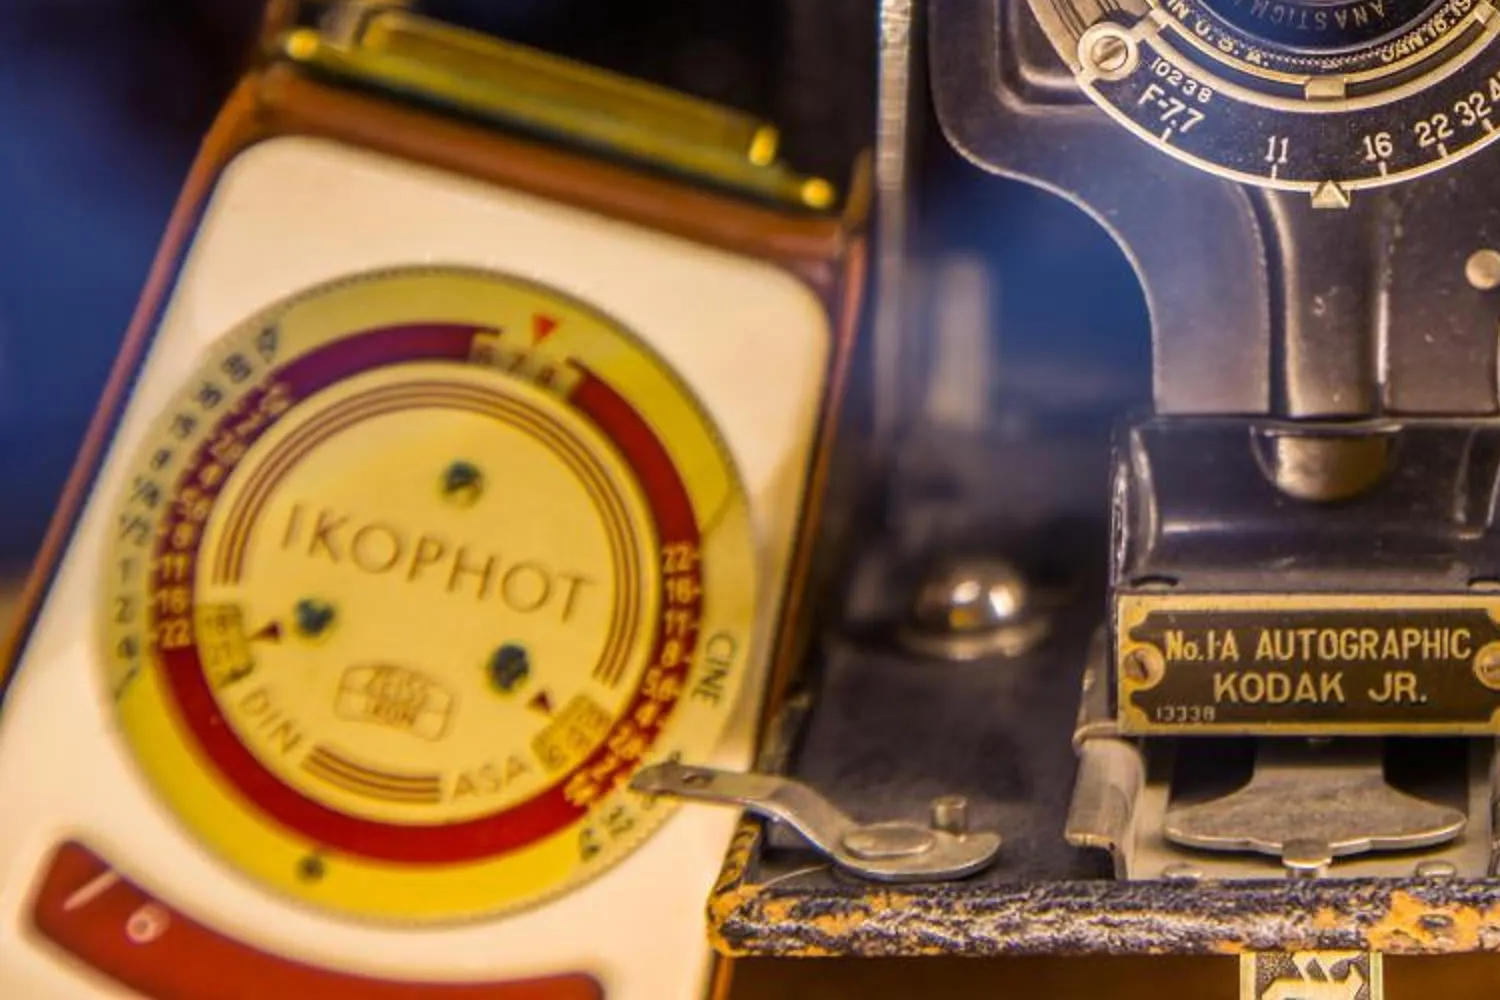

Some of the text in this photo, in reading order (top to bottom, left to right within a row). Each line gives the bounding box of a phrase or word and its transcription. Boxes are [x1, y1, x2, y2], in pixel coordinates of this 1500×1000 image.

[1150, 56, 1215, 105] 10238
[1265, 135, 1290, 164] 11
[1362, 131, 1394, 162] 16
[1413, 112, 1455, 148] 22
[1455, 91, 1493, 129] 32
[280, 502, 598, 624] IKOPHOT
[692, 628, 740, 707] CINE
[1254, 628, 1472, 662] AUTOGRAPHIC
[1212, 671, 1428, 704] KODAK JR.
[237, 686, 303, 756] DIN
[452, 754, 530, 801] ASA
